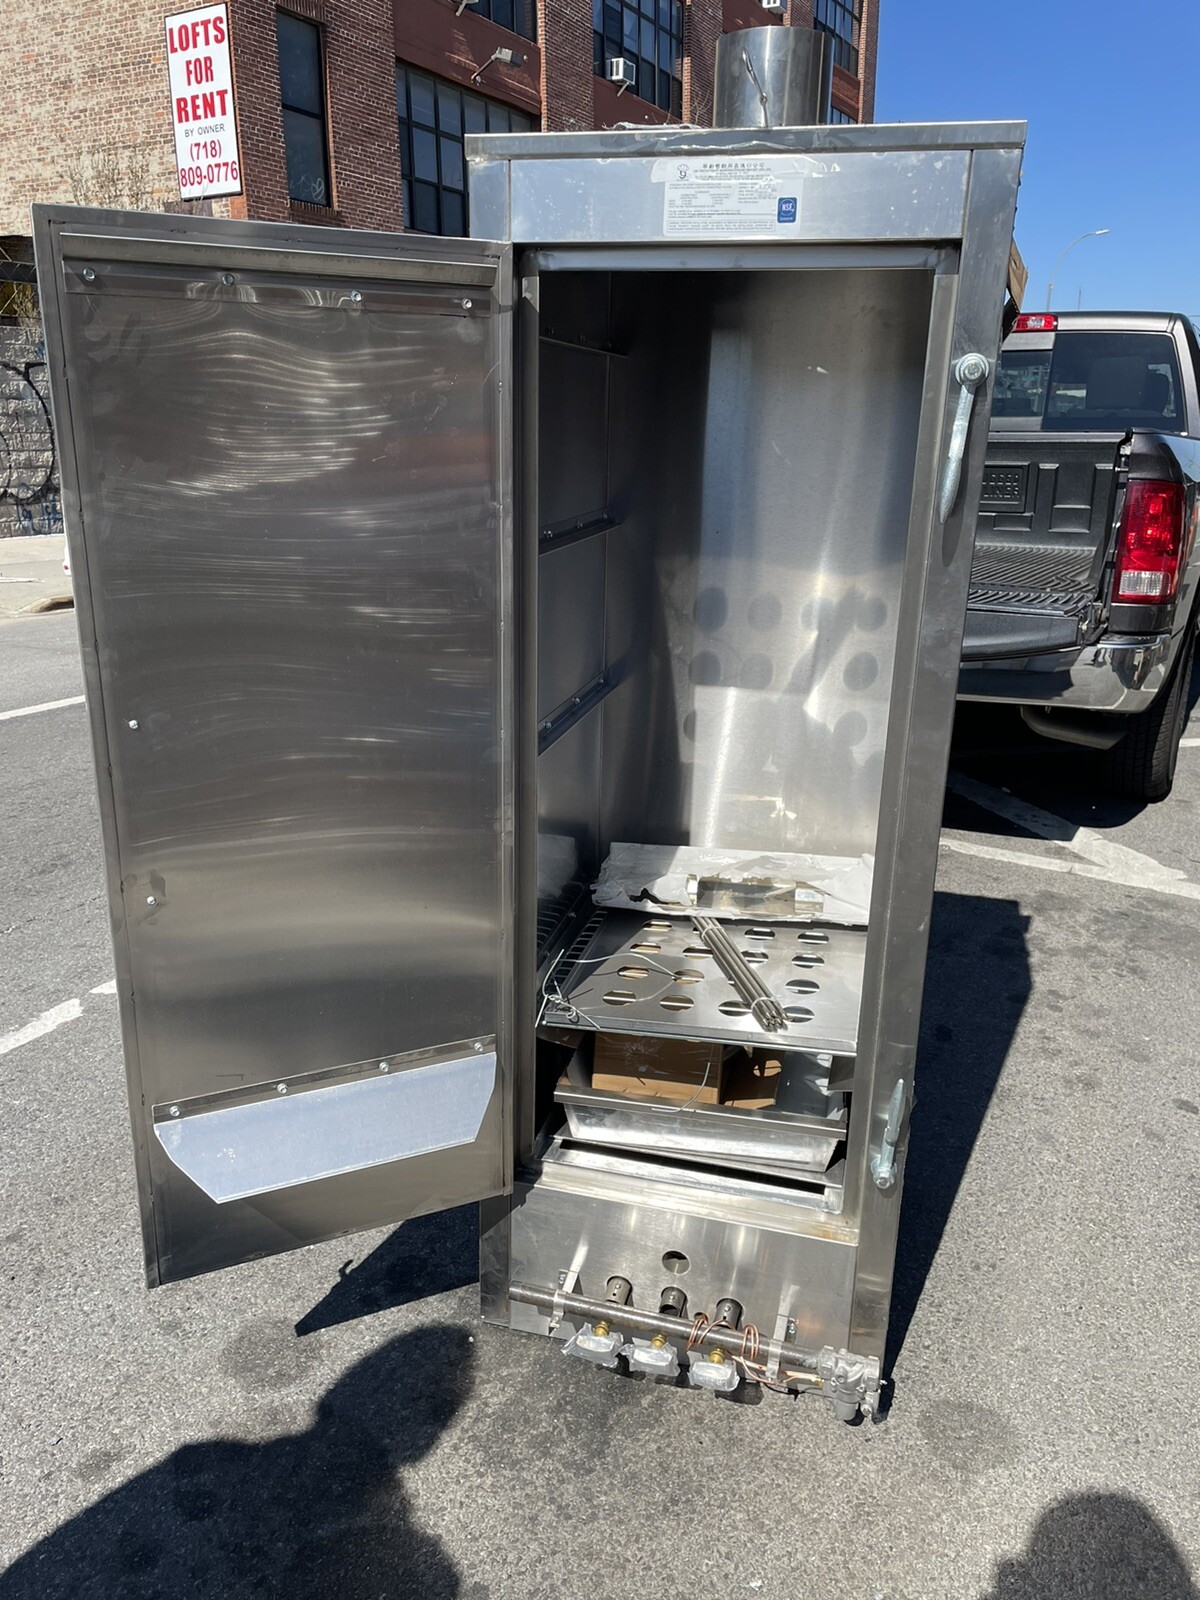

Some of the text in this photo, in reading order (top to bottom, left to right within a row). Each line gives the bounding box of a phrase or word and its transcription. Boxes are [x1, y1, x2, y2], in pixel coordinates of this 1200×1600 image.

[168, 15, 226, 54] LOFTS
[185, 55, 214, 87] FOR
[175, 89, 229, 124] RENT
[184, 123, 226, 138] BY OWNER
[189, 139, 222, 162] (718)
[180, 160, 239, 187] 809-0776
